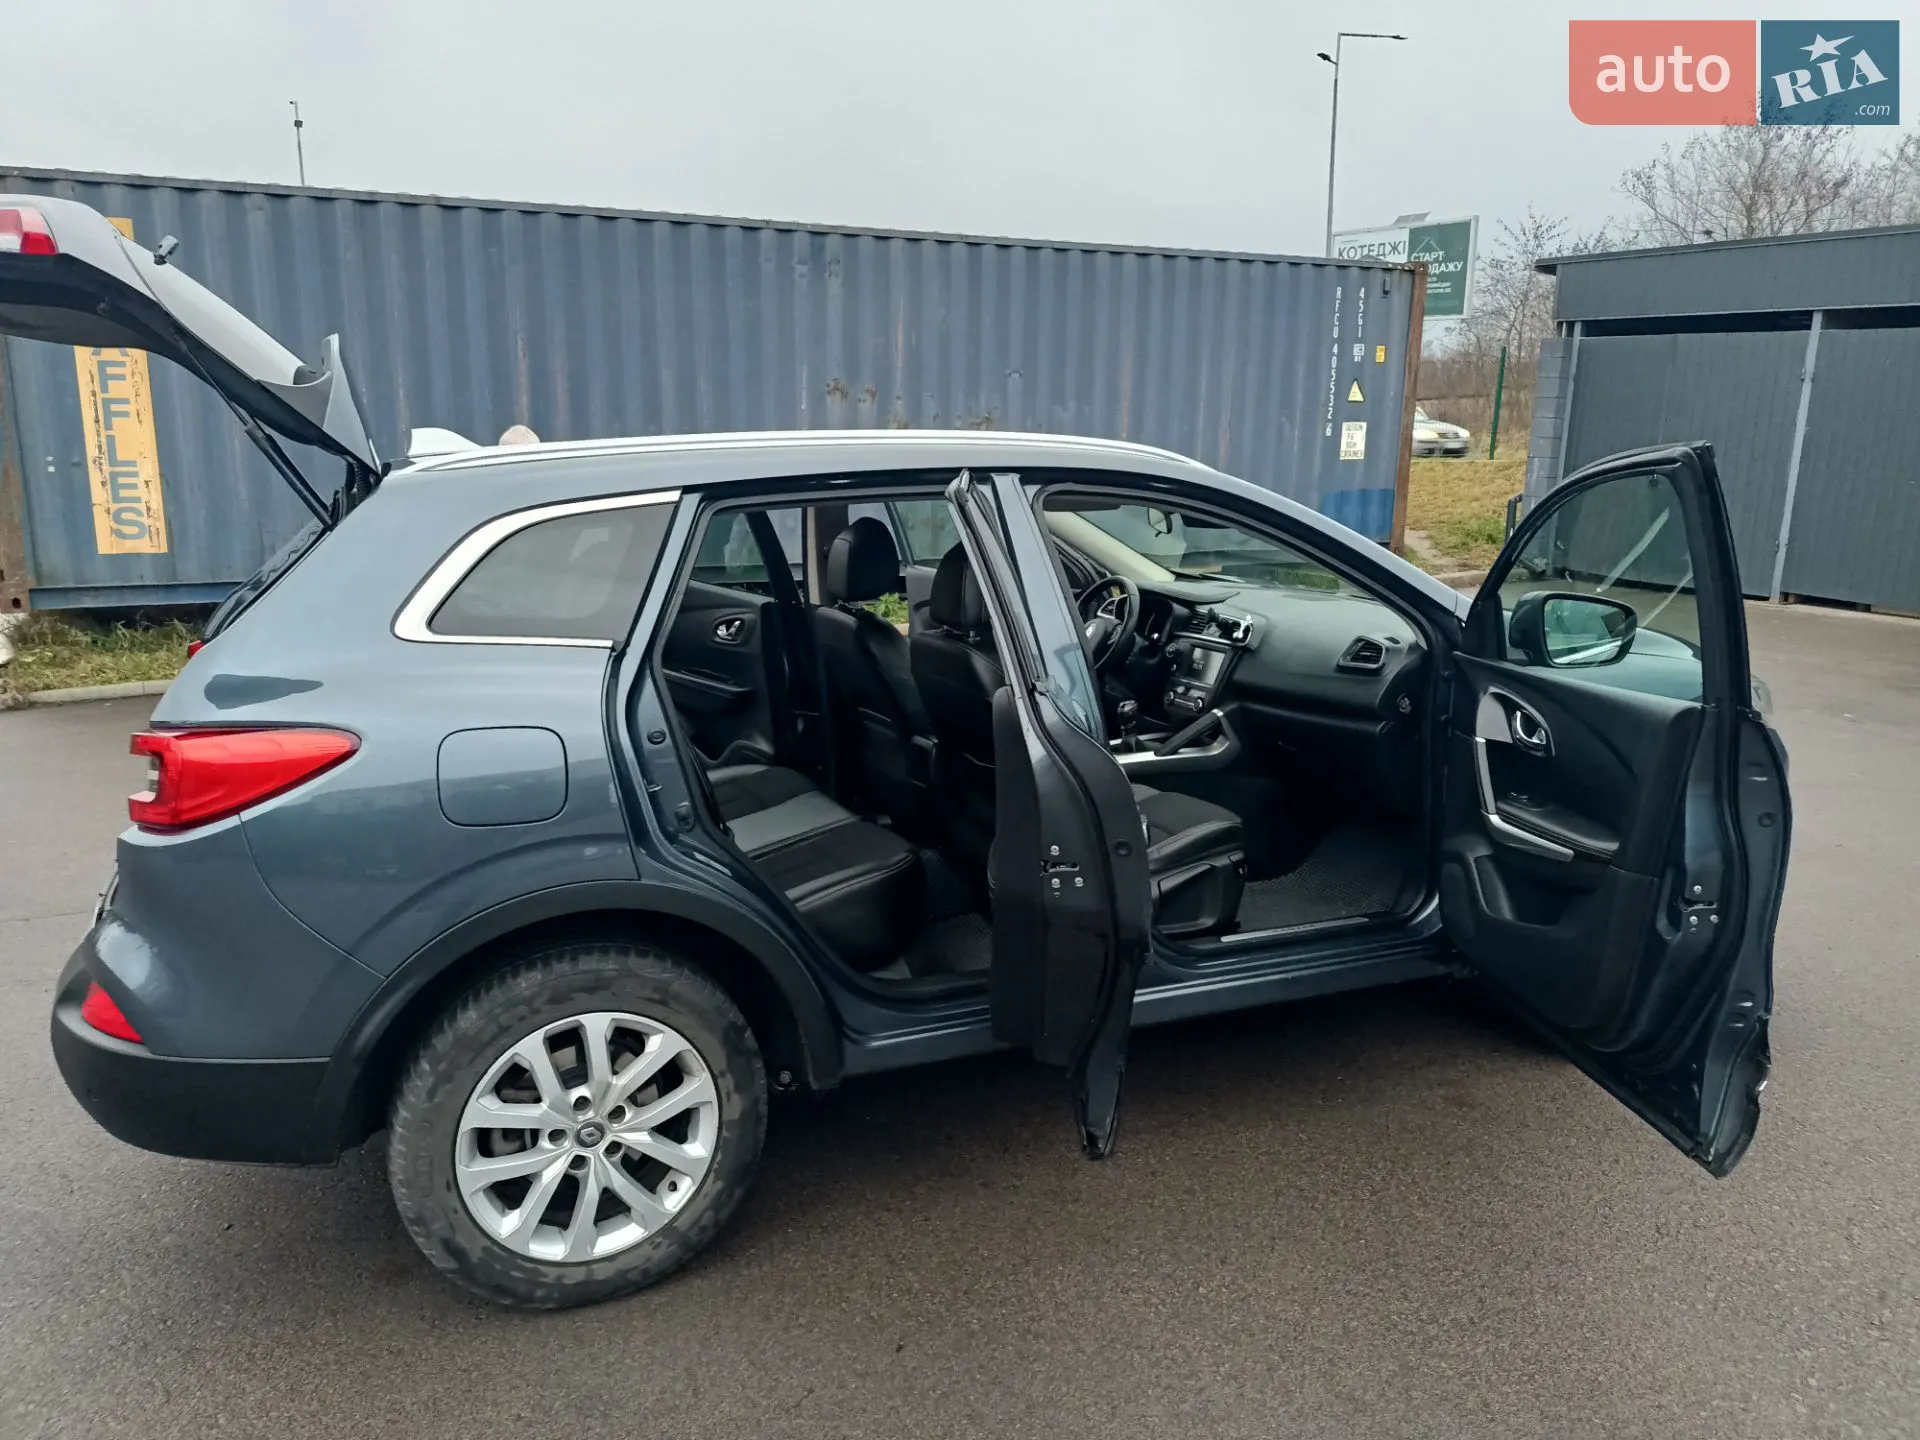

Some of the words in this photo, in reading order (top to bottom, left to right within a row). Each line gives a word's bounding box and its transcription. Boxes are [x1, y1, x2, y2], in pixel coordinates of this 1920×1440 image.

[1338, 240, 1407, 260] КОТЕДЖІ
[1411, 251, 1445, 261] СТАРТ
[1428, 261, 1464, 275] ДАЖУ
[91, 348, 148, 540] FFLES
